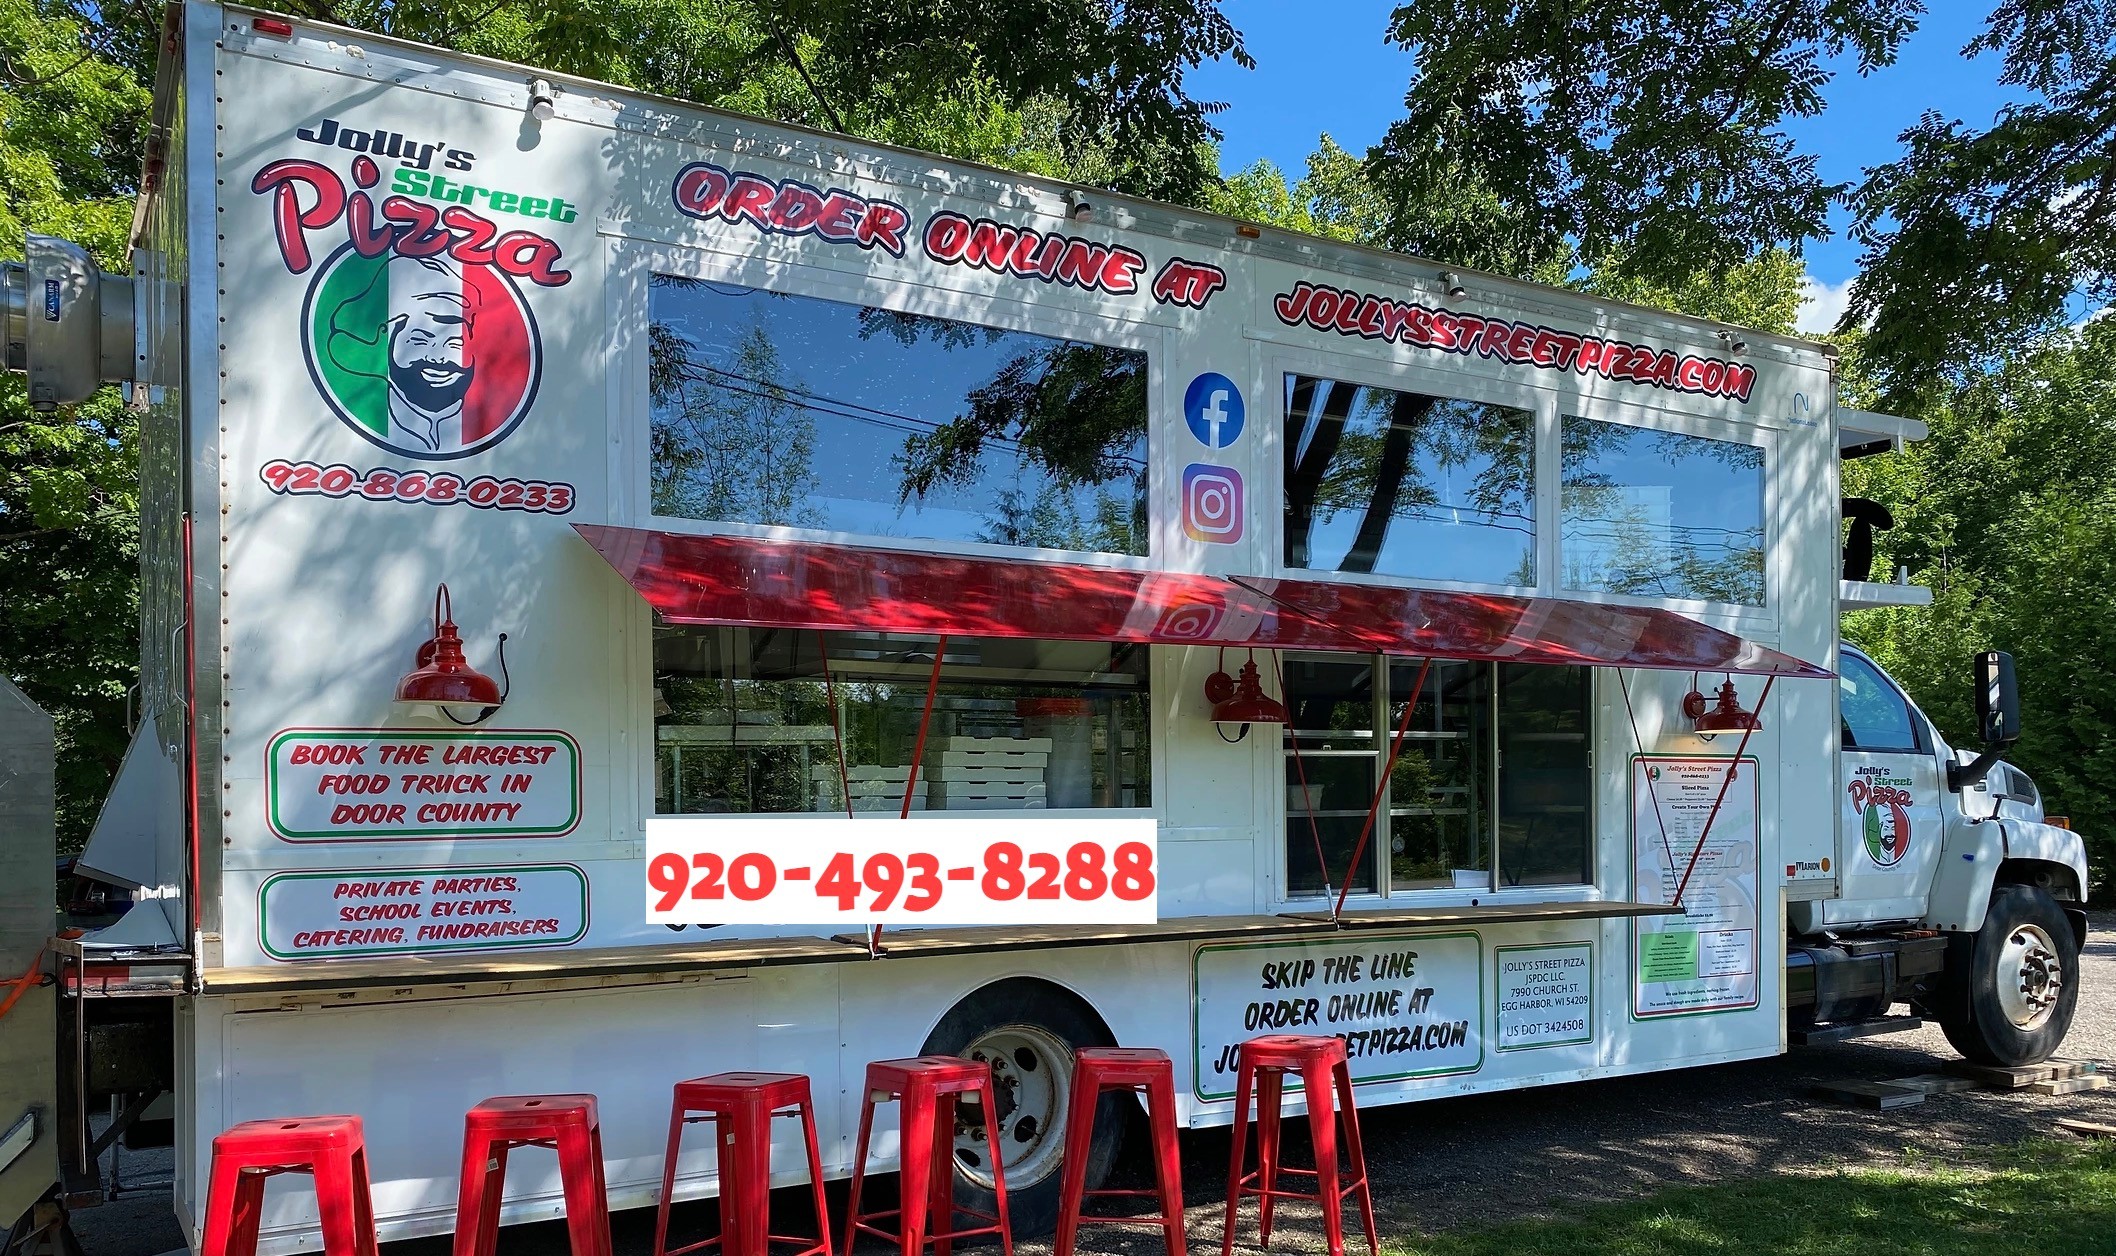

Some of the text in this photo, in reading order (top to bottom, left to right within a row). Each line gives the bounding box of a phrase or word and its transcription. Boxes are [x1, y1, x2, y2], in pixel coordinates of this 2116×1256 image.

[297, 119, 477, 172] Jolly's
[391, 168, 579, 224] Street
[251, 155, 571, 287] Pizza
[672, 161, 1227, 309] ORDER ONLINE AT
[1273, 280, 1758, 403] JOLLYSSTREETPIZZA.COM
[260, 459, 576, 515] 920-868-0233
[290, 744, 557, 765] BOOK THE LARGEST
[1855, 767, 1890, 777] Jolly's
[1874, 777, 1912, 786] Street
[318, 774, 532, 795] FOOD TRUCK IN
[1848, 775, 1913, 815] Pizza
[330, 802, 522, 825] DOOR COUNTY
[333, 877, 522, 900] PRIVATE PARTIES,
[339, 899, 517, 922] SCHOOL EVENTS,
[293, 918, 558, 948] CATERING, FUNDRAISERS
[1262, 951, 1418, 989] SKIP THE LINE
[1504, 958, 1586, 974] JOLLY'S STREET PIZZA
[1525, 971, 1565, 985] JSPDC LLC.
[1511, 983, 1579, 997] 7990 CHURCH ST.
[1244, 987, 1434, 1031] ORDER ONLINE AT
[1502, 996, 1588, 1011] EGG HARBOR, WI 54209
[1506, 1019, 1584, 1037] US DOT 3424508
